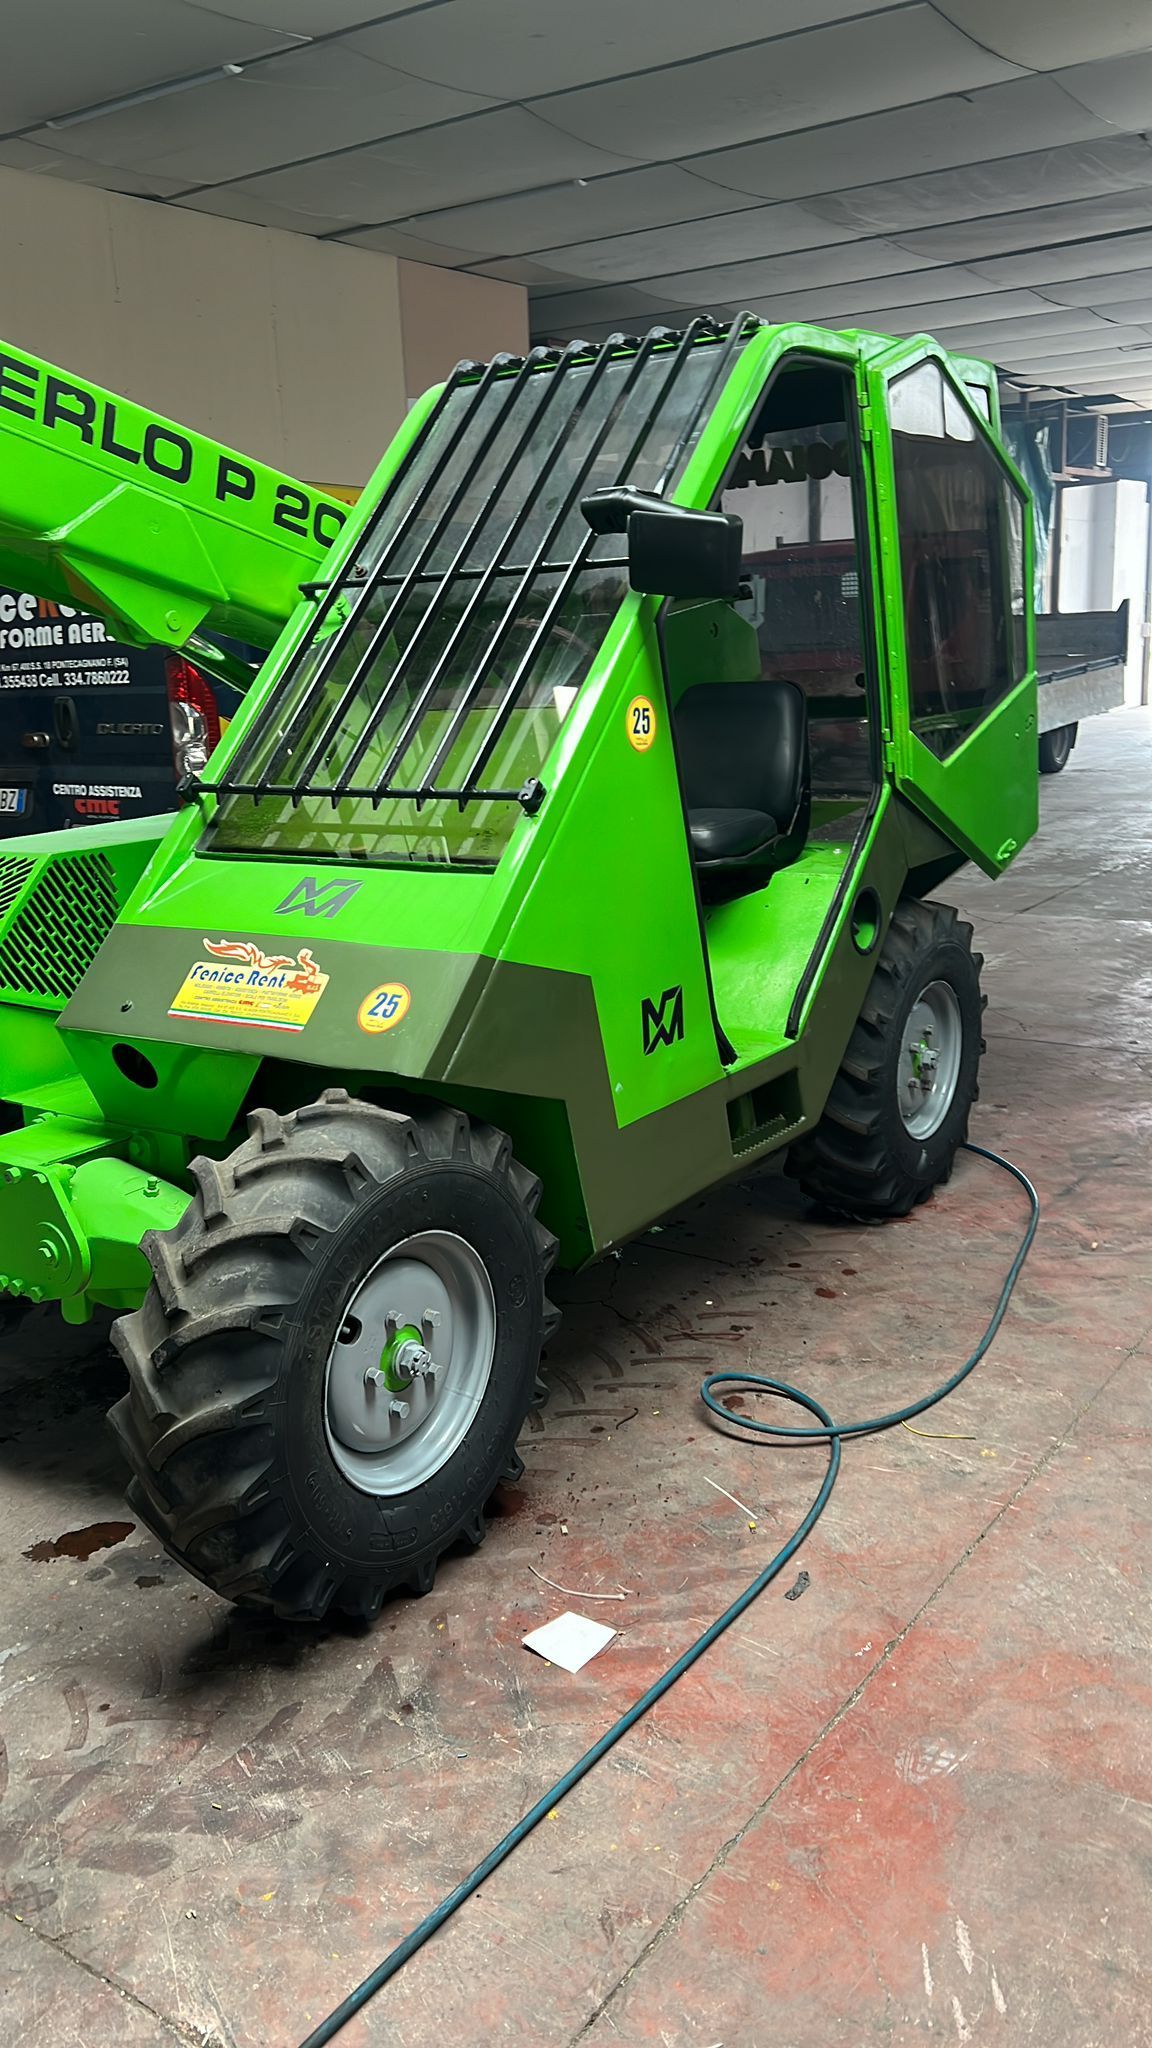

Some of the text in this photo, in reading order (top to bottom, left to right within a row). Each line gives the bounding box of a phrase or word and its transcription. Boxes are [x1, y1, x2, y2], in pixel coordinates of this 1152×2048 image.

[0, 353, 193, 485] ERLO
[215, 455, 256, 501] P
[67, 622, 116, 644] AER
[97, 723, 164, 735] DUCATO
[633, 707, 650, 734] 25
[0, 791, 17, 810] BZ
[52, 783, 142, 798] CENTRO ASSISTENZA
[74, 798, 121, 815] cmc
[190, 965, 245, 983] Fenice
[246, 970, 286, 988] Rent
[368, 992, 403, 1019] 25
